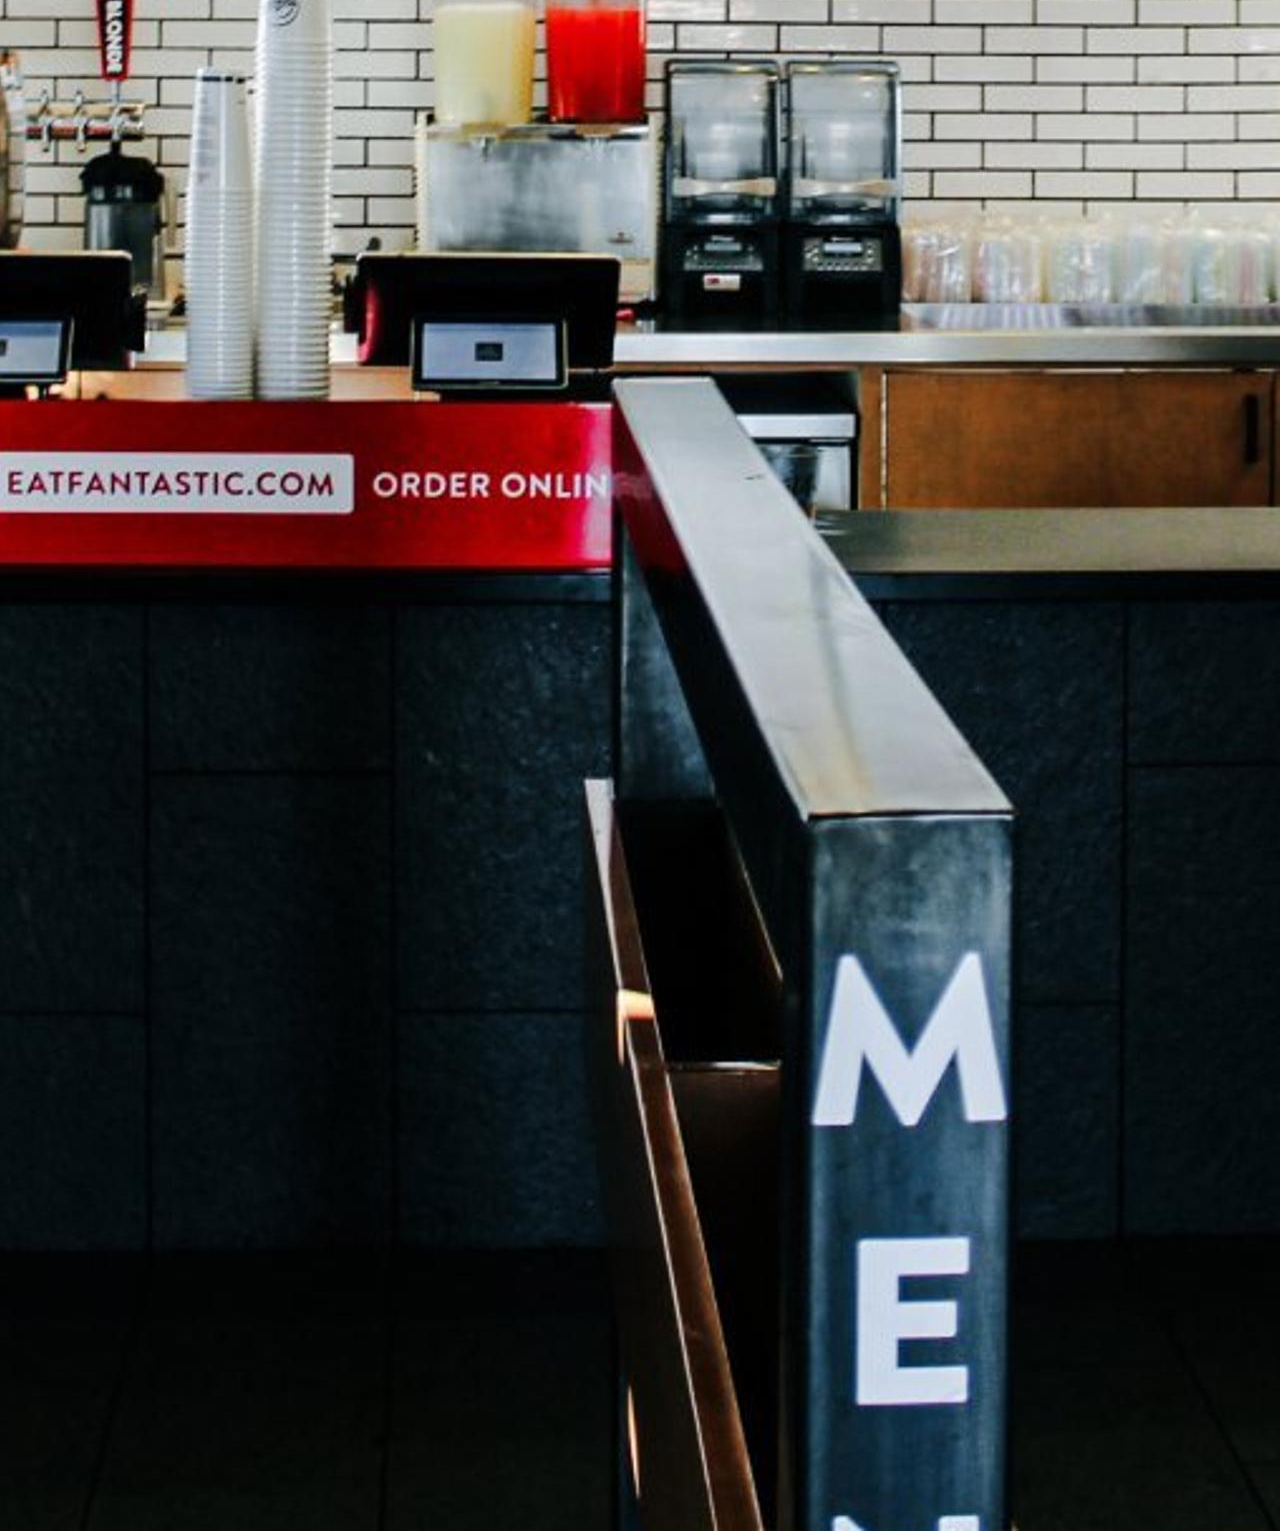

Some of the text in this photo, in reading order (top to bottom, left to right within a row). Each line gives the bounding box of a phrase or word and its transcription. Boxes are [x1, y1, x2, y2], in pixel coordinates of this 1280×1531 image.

[8, 471, 334, 497] EATFANTASTIC.COM
[372, 471, 490, 499] ORDER
[500, 472, 611, 500] ONLIN
[811, 951, 1007, 1531] ME
